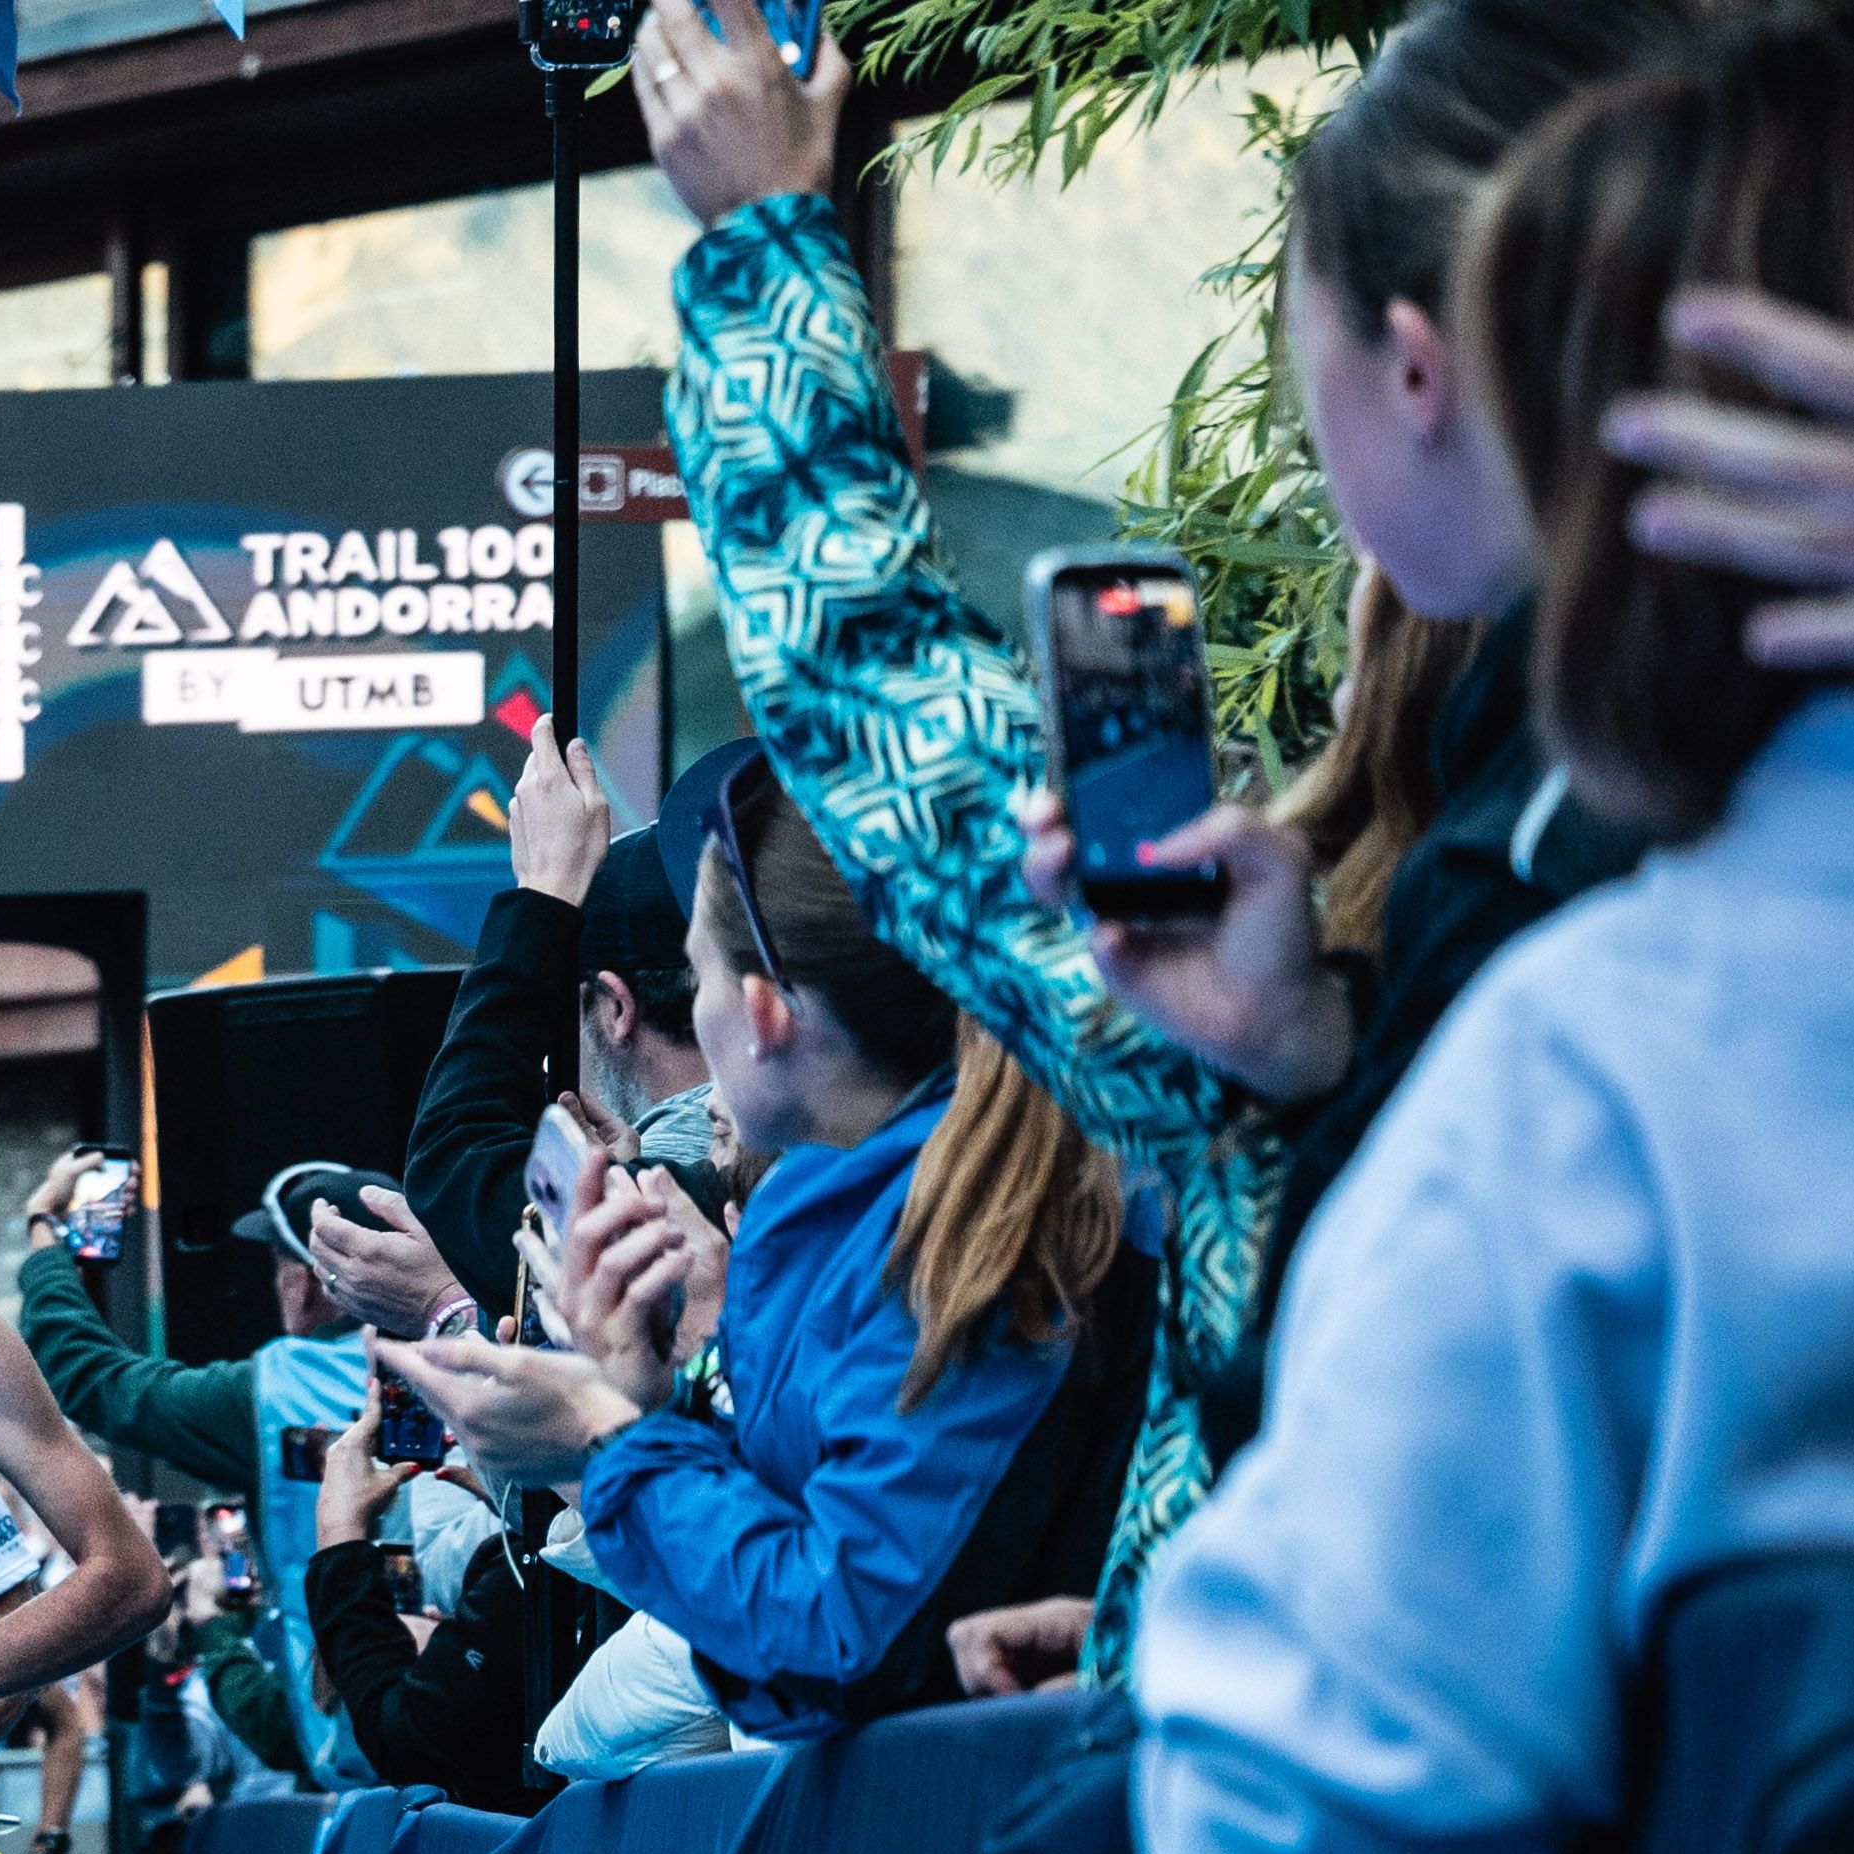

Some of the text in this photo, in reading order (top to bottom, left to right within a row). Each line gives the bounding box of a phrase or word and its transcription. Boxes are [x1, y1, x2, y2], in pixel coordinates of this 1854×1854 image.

[240, 524, 554, 584] TRAIL 100
[238, 583, 554, 639] ANDORRA
[180, 674, 435, 711] BY UTMB
